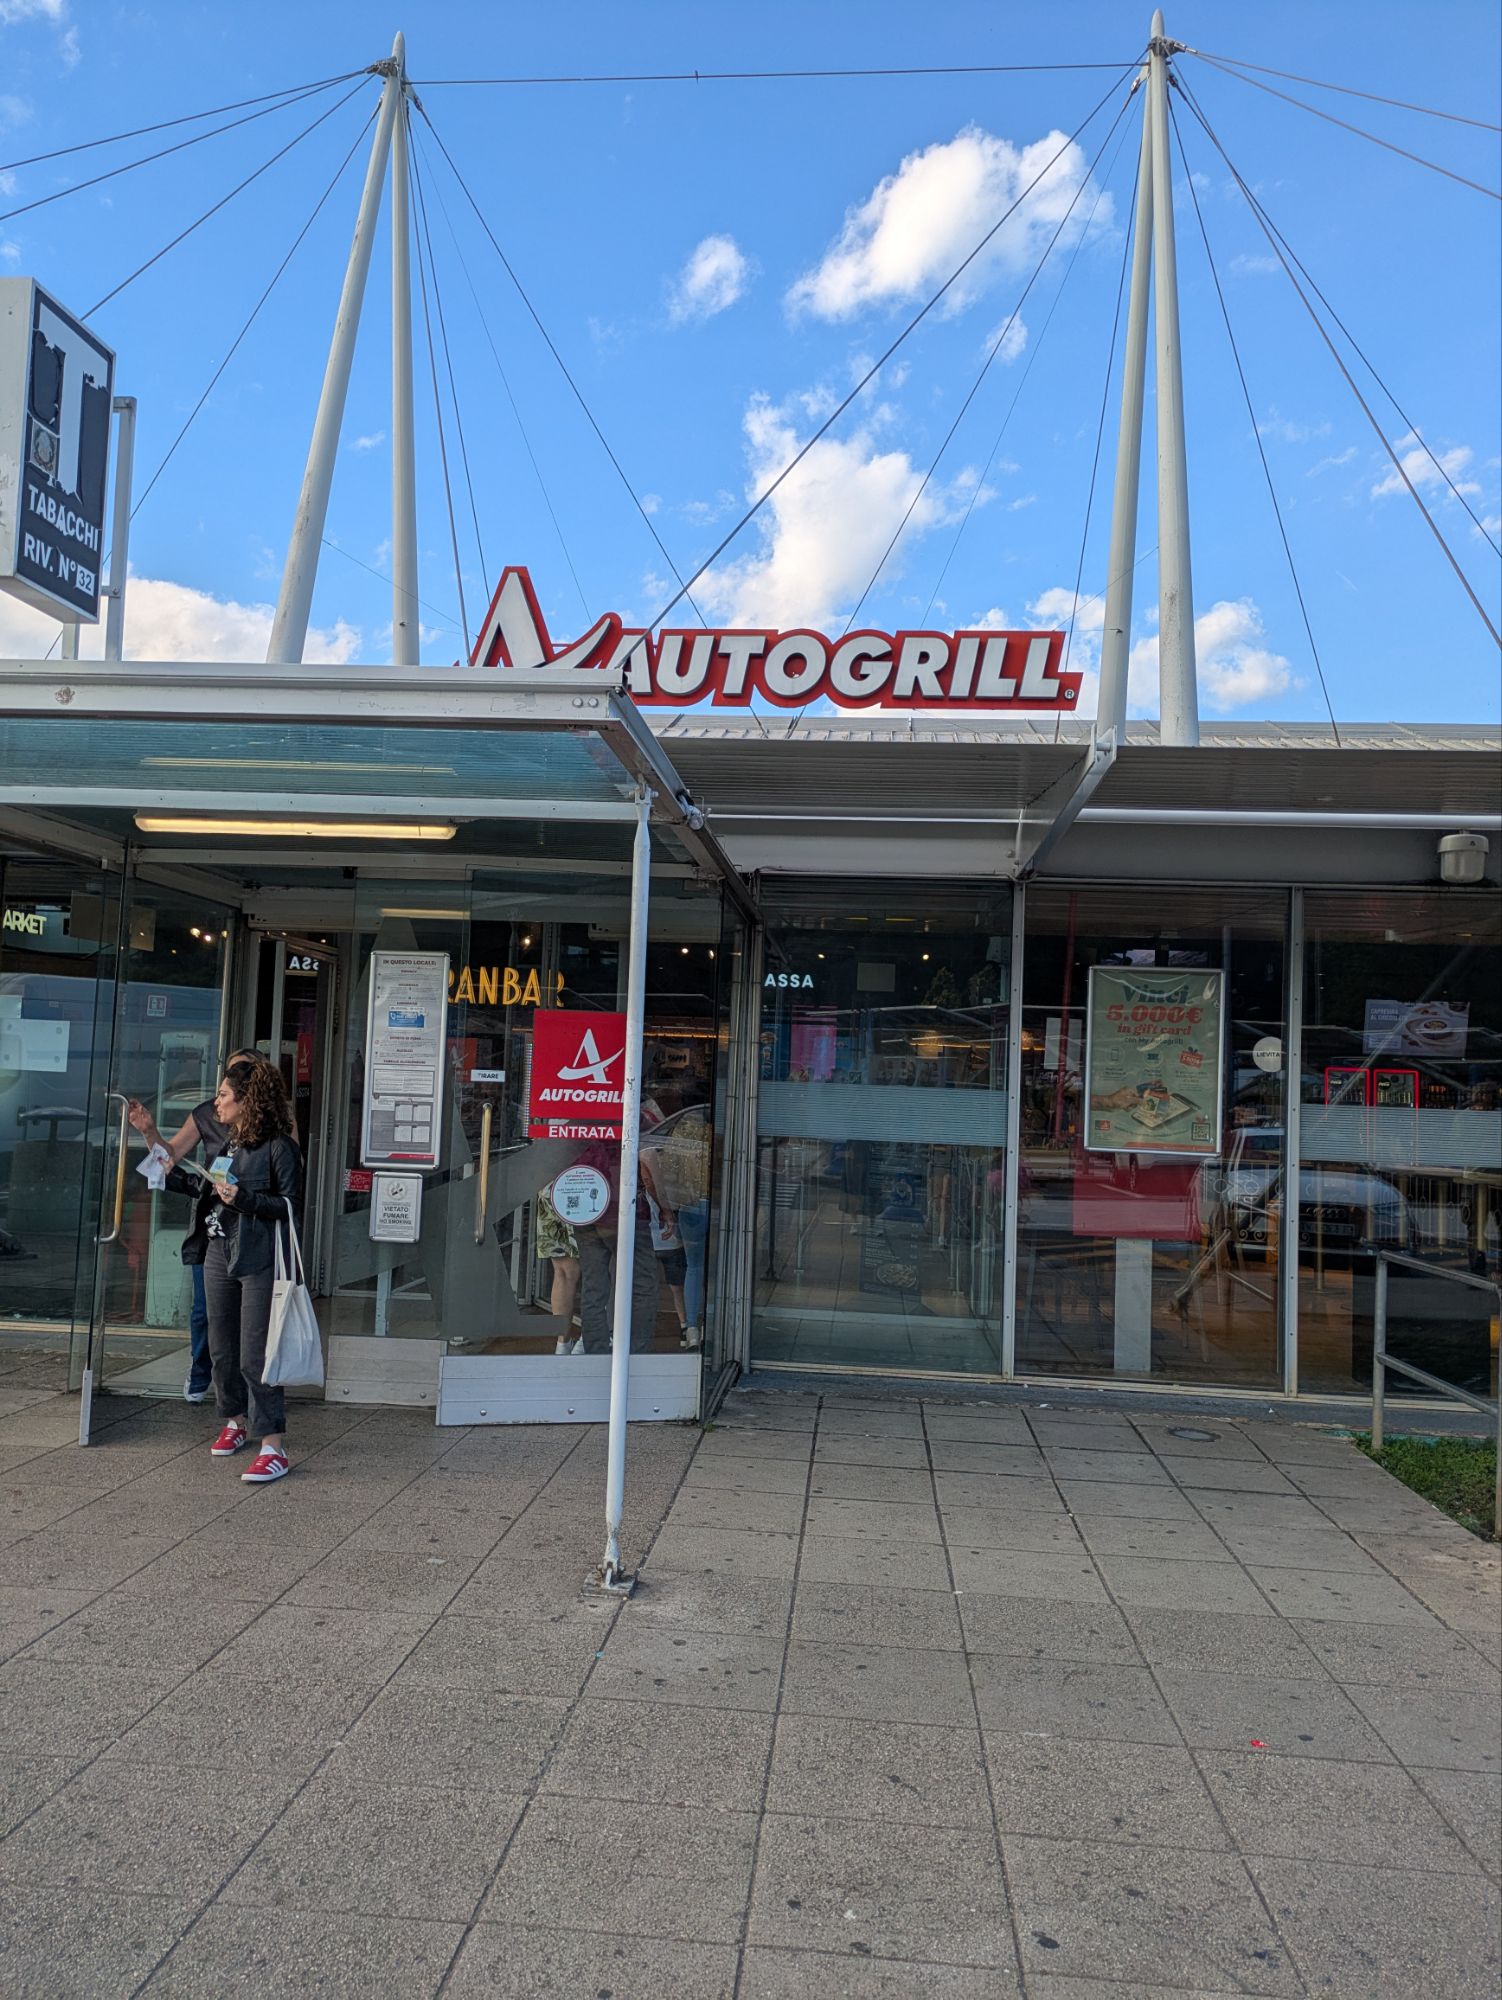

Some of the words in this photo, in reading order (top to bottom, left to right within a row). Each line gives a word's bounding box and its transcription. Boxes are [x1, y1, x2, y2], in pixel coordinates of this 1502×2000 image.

[28, 484, 99, 552] TABACCHI
[24, 532, 54, 573] RIV.
[612, 633, 1061, 699] AUTOGRILL
[2, 908, 48, 936] ARKET
[764, 973, 814, 988] ASSA
[1123, 984, 1189, 1003] Vinci
[1105, 1003, 1205, 1024] 5.000€
[1117, 1024, 1132, 1034] in
[1133, 1023, 1157, 1037] gift
[1160, 1024, 1193, 1036] card
[478, 1072, 500, 1080] TIRARE
[548, 1125, 616, 1139] ENTRATA
